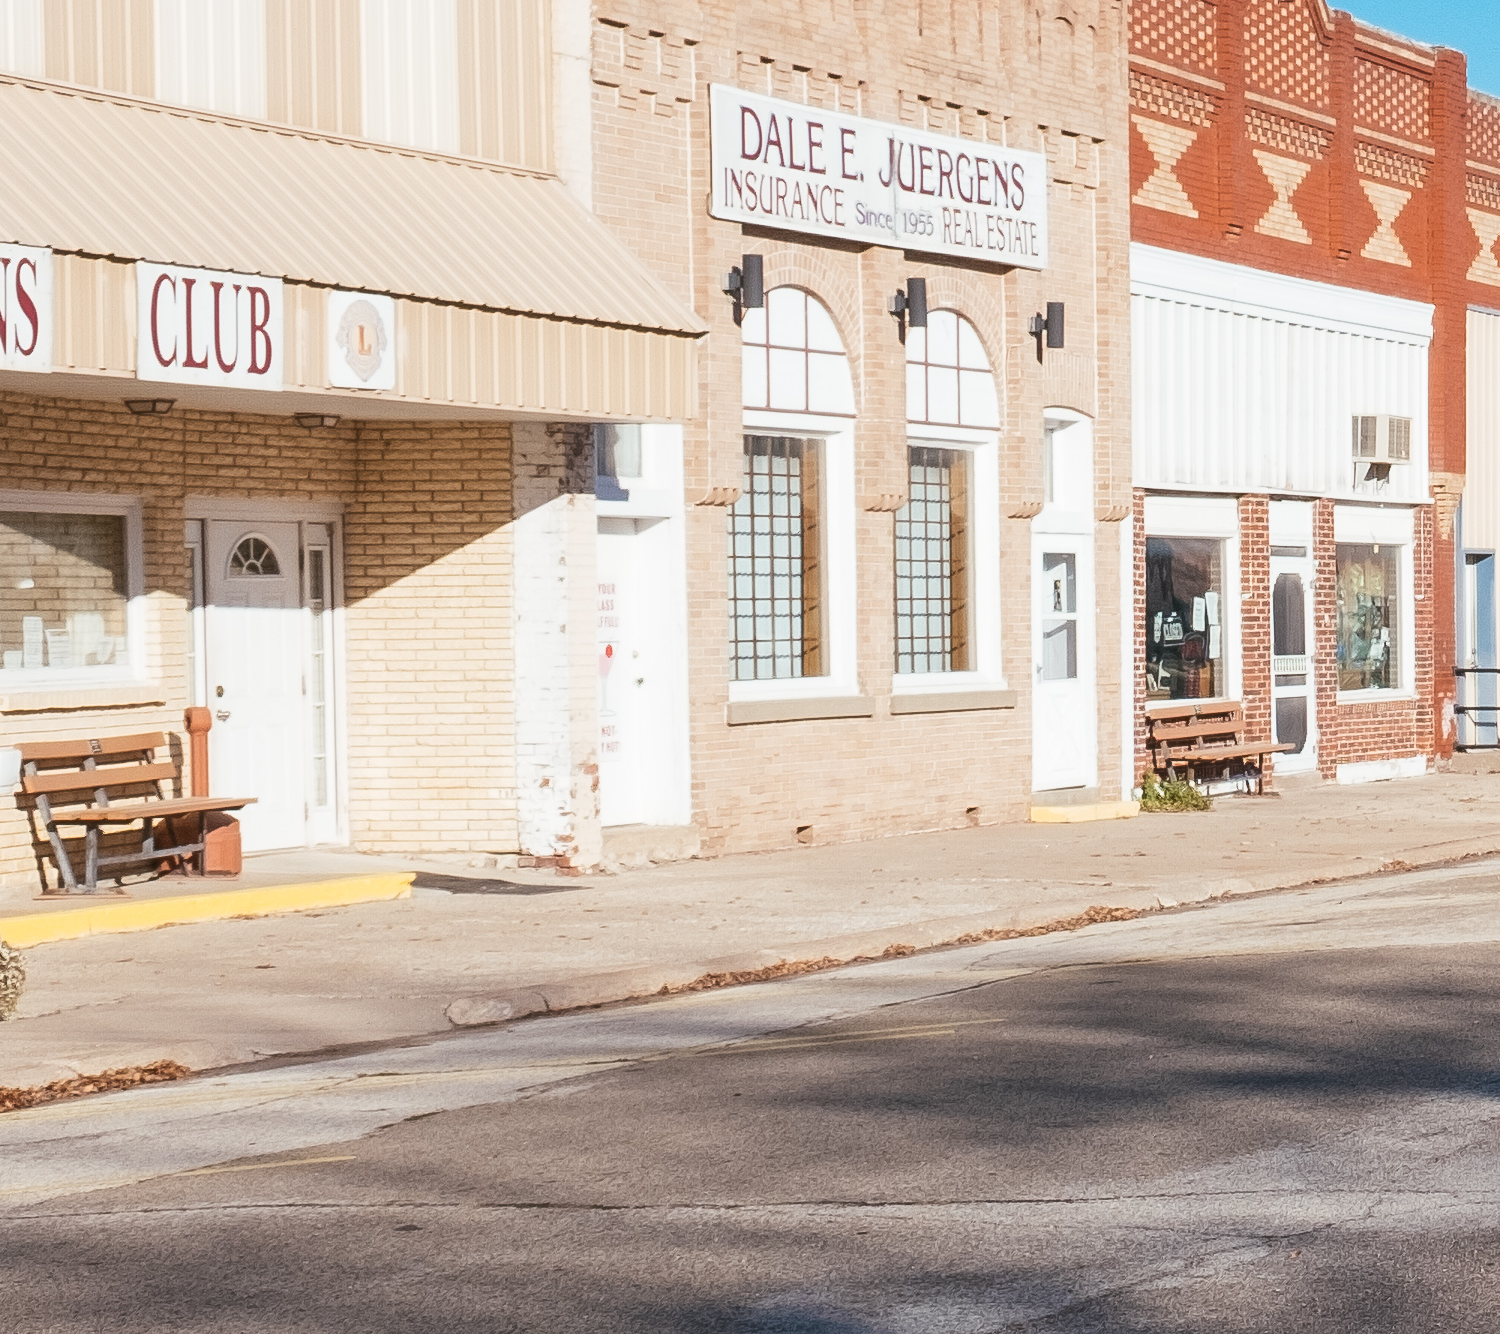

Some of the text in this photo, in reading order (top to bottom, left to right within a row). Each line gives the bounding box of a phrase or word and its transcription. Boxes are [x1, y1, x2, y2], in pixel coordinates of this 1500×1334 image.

[740, 105, 1025, 211] DALE E. JUERGENS
[724, 167, 1039, 257] INSURANCE Since 1955 REAL ESTATE
[151, 273, 273, 375] CLUB
